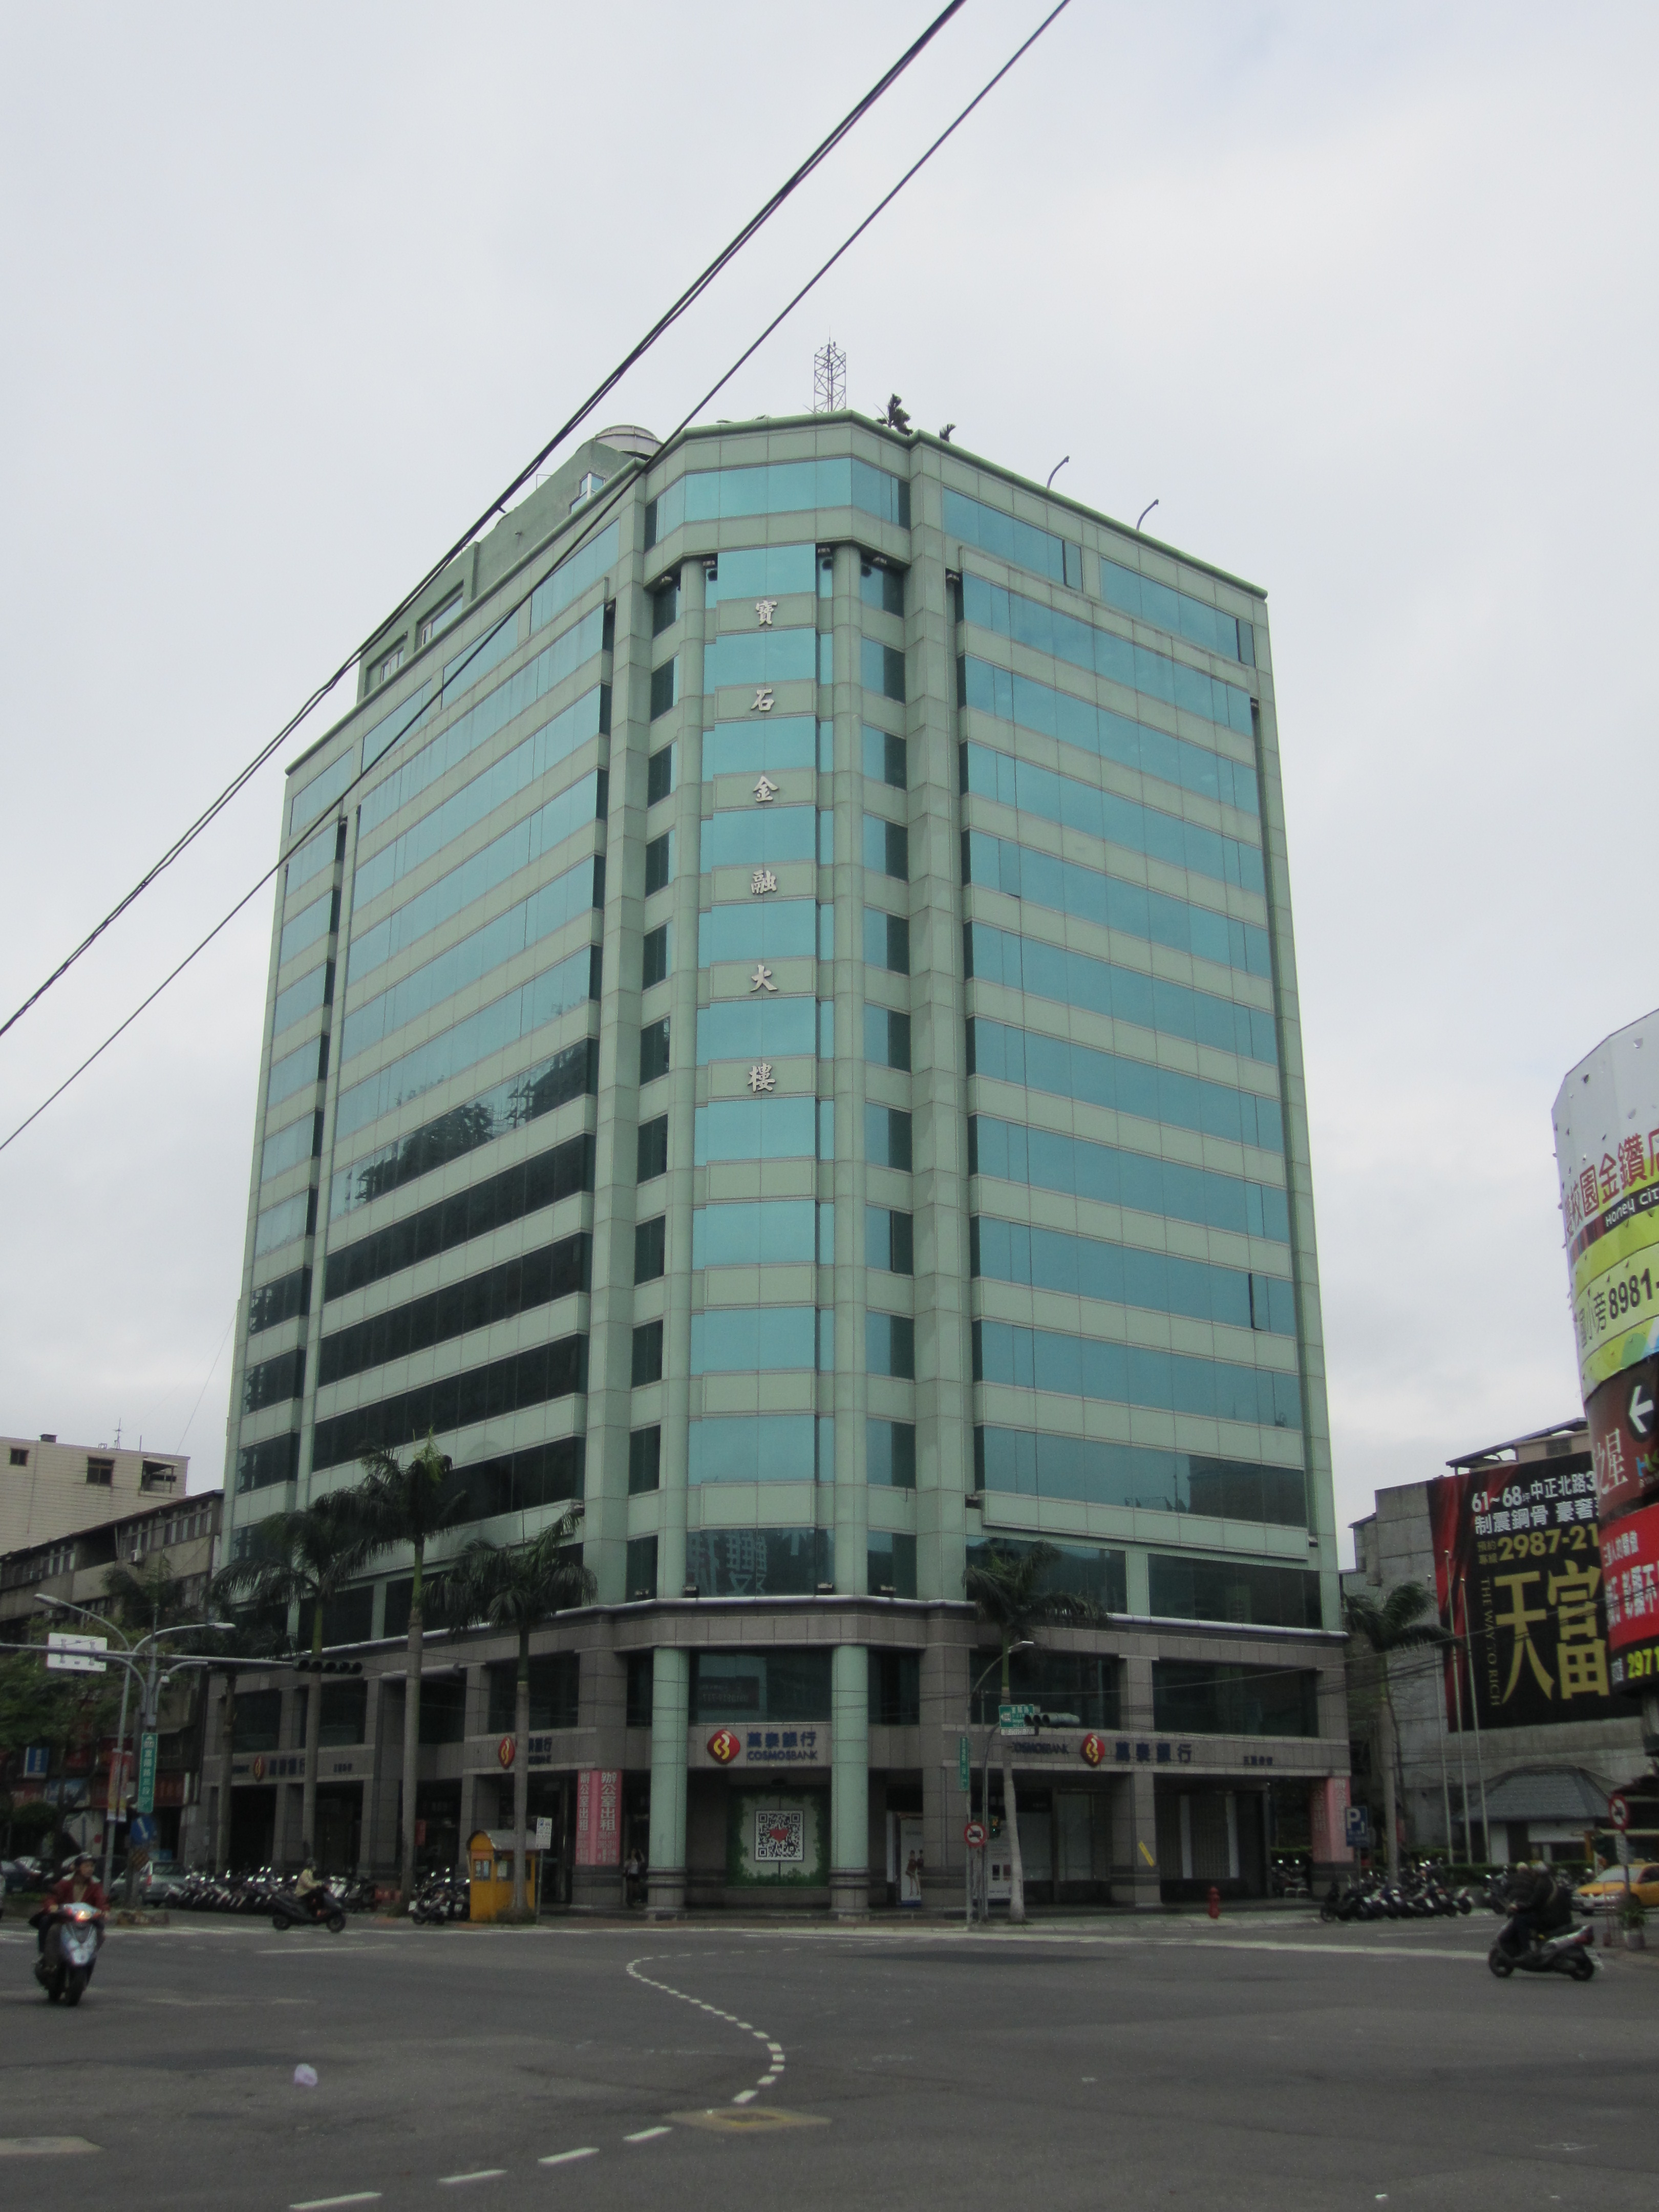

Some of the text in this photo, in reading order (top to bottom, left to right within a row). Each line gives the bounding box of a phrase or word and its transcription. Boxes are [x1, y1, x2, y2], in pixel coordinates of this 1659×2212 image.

[1474, 1497, 1599, 1536] 制震鋼骨 豪奢
[1481, 1577, 1501, 1706] THE WAY TO RICH
[747, 1750, 818, 1761] COSMOSBANK
[600, 1772, 618, 1832] 辦公室出租
[1346, 1808, 1361, 1830] P
